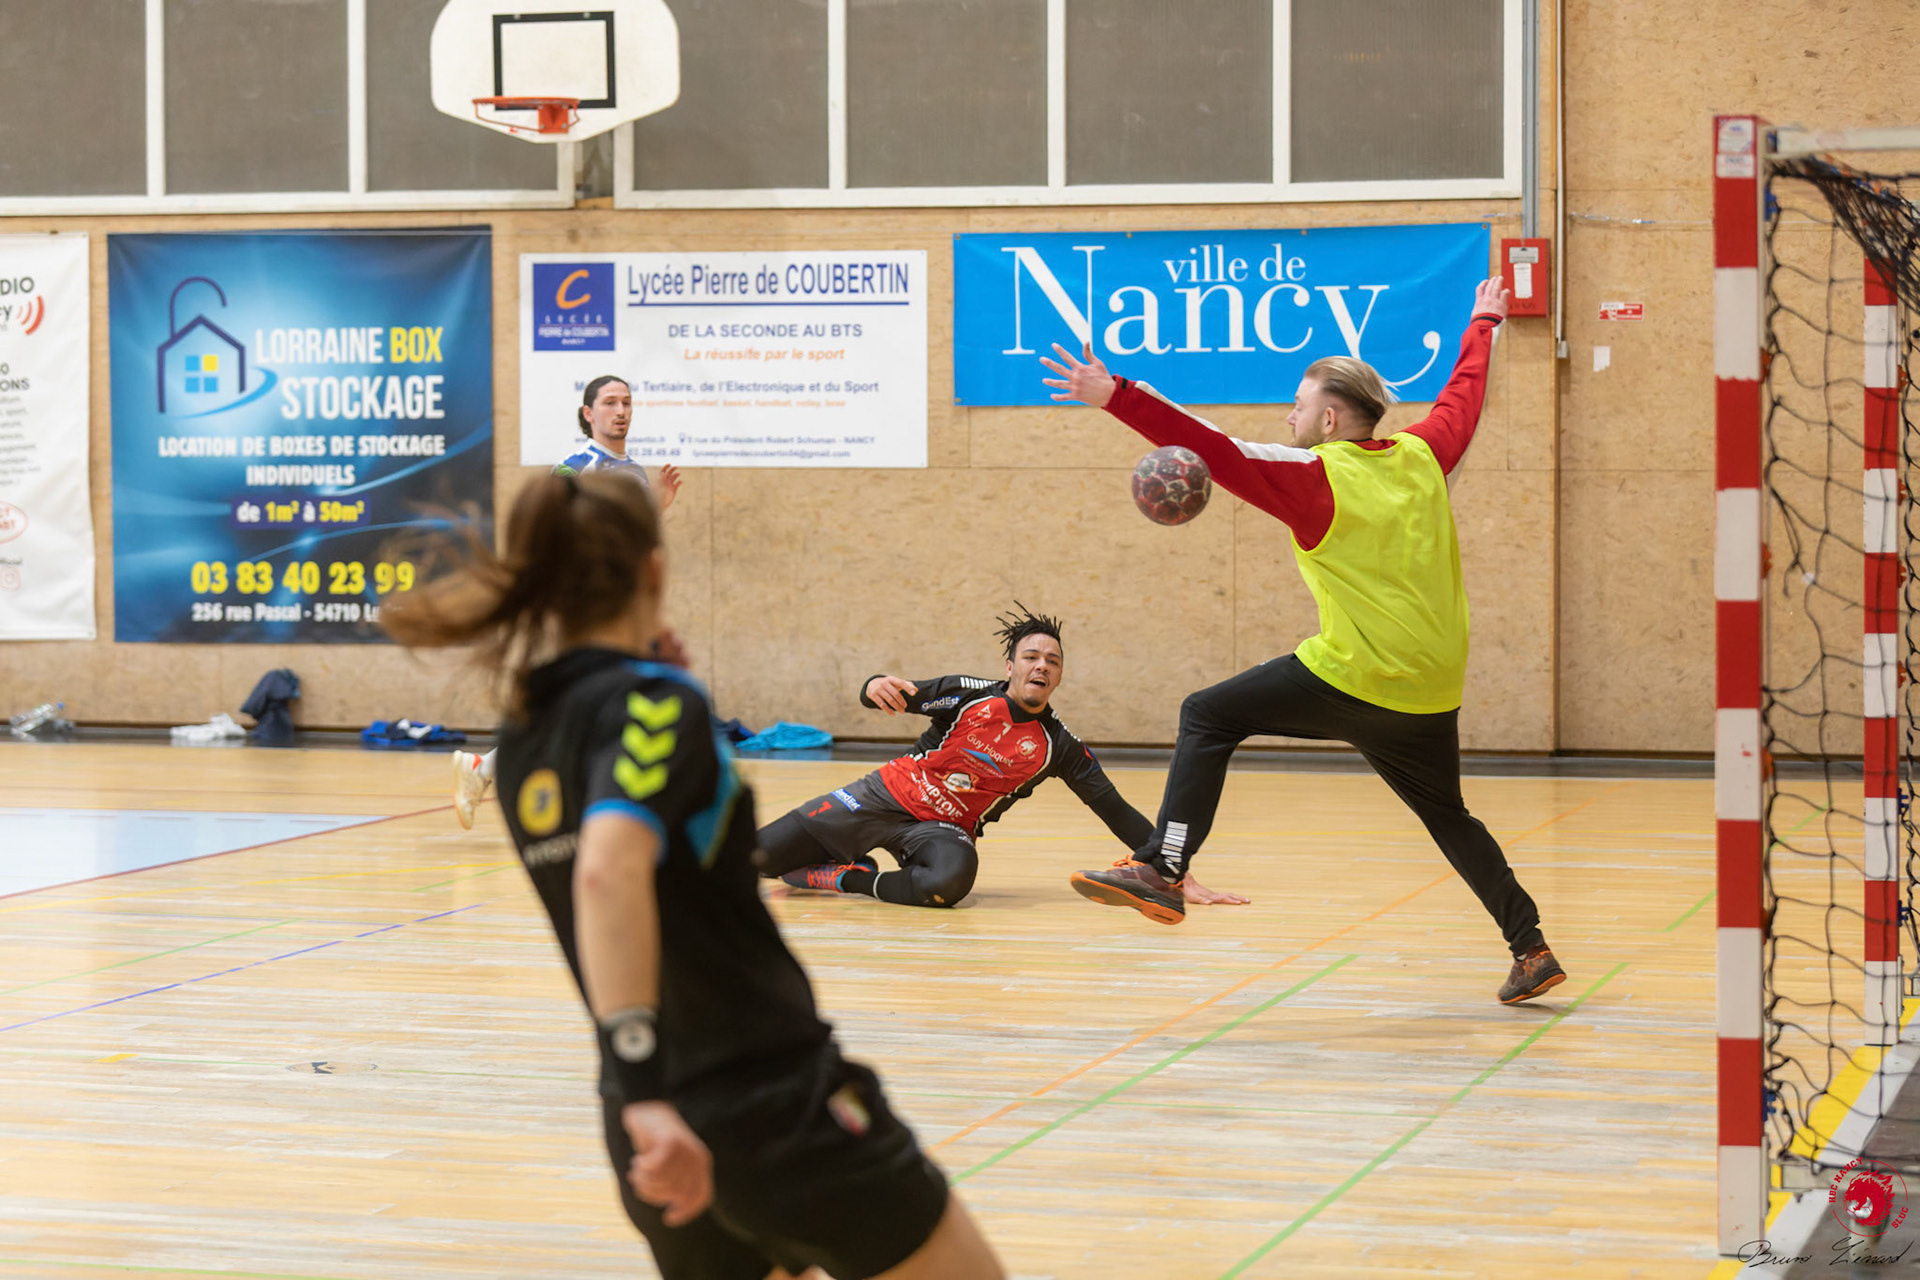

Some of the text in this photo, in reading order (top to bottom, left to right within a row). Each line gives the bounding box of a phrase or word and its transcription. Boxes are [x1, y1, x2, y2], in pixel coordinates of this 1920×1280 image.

[1163, 243, 1306, 283] ville de
[628, 263, 908, 304] Lycée Pierre de COUBERTIN
[1001, 245, 1441, 386] Nancy
[668, 324, 863, 338] DE LA SECONDE AU BTS
[256, 326, 443, 364] LORRAINE BOX
[684, 347, 845, 362] La réussite par le sport
[281, 375, 445, 420] STOCKAGE
[644, 381, 696, 393] Tertiaire,
[700, 381, 715, 392] de
[719, 381, 805, 394] l'Electronique
[809, 382, 821, 392] et
[825, 381, 840, 392] du
[844, 381, 879, 394] Sport
[158, 435, 446, 457] LOCATION DE BOXES DE STOCKAGE
[246, 464, 356, 486] INDIVIDUELS
[236, 501, 261, 523] de
[302, 501, 316, 523] à
[191, 560, 415, 594] 03 83 40 23 99
[191, 603, 223, 622] 256
[225, 606, 252, 622] rue
[254, 603, 301, 622] Pascal
[314, 602, 361, 622] 54710
[993, 722, 1012, 743] 7
[967, 733, 985, 748] Guy
[983, 744, 1015, 767] Hoquet
